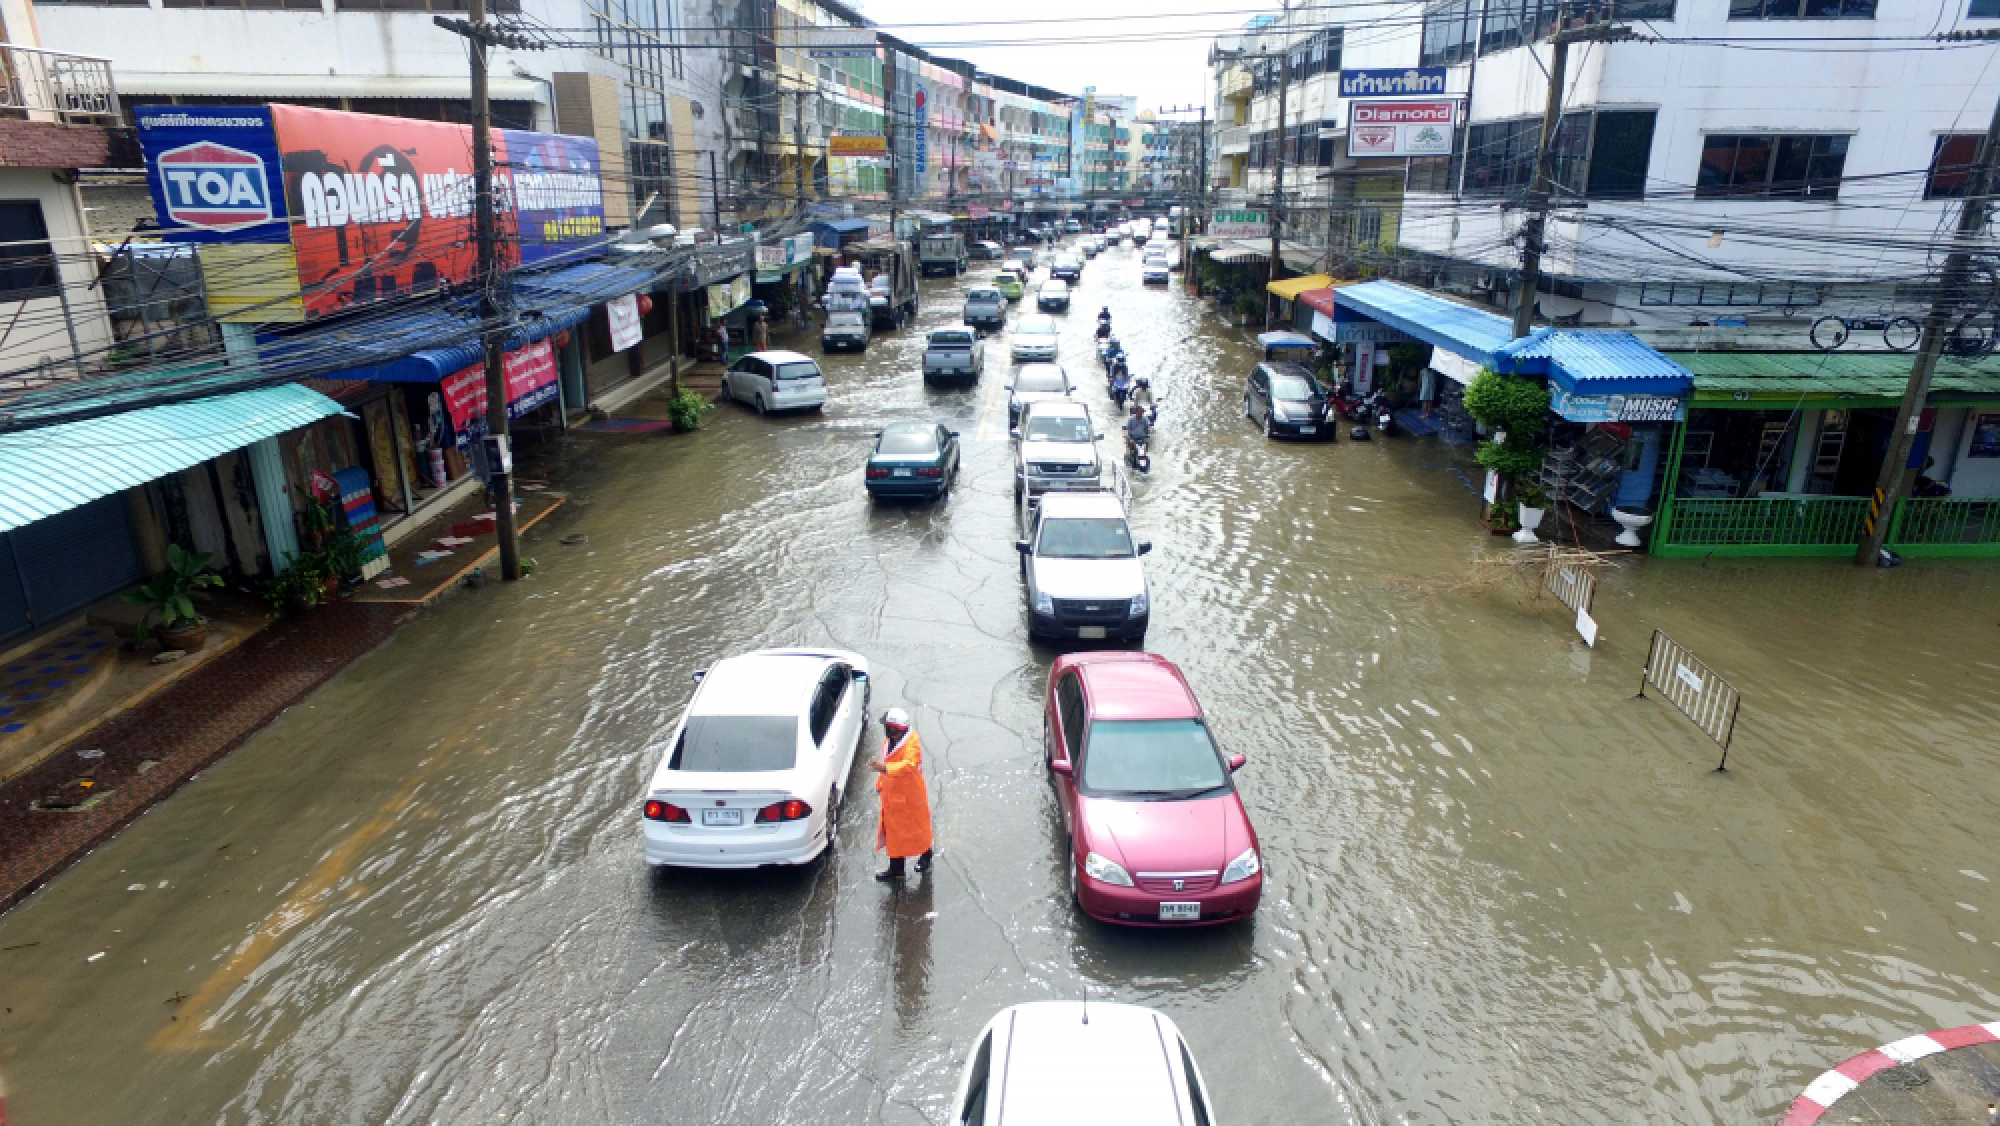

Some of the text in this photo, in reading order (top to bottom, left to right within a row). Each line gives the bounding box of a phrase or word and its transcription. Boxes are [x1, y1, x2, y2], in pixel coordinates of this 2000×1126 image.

[1343, 69, 1443, 93] เก้านาฬิกา
[1356, 107, 1449, 121] Diamond
[167, 171, 262, 205] TOA
[1624, 398, 1679, 411] MUSIC
[1620, 410, 1674, 421] FESTIVAL
